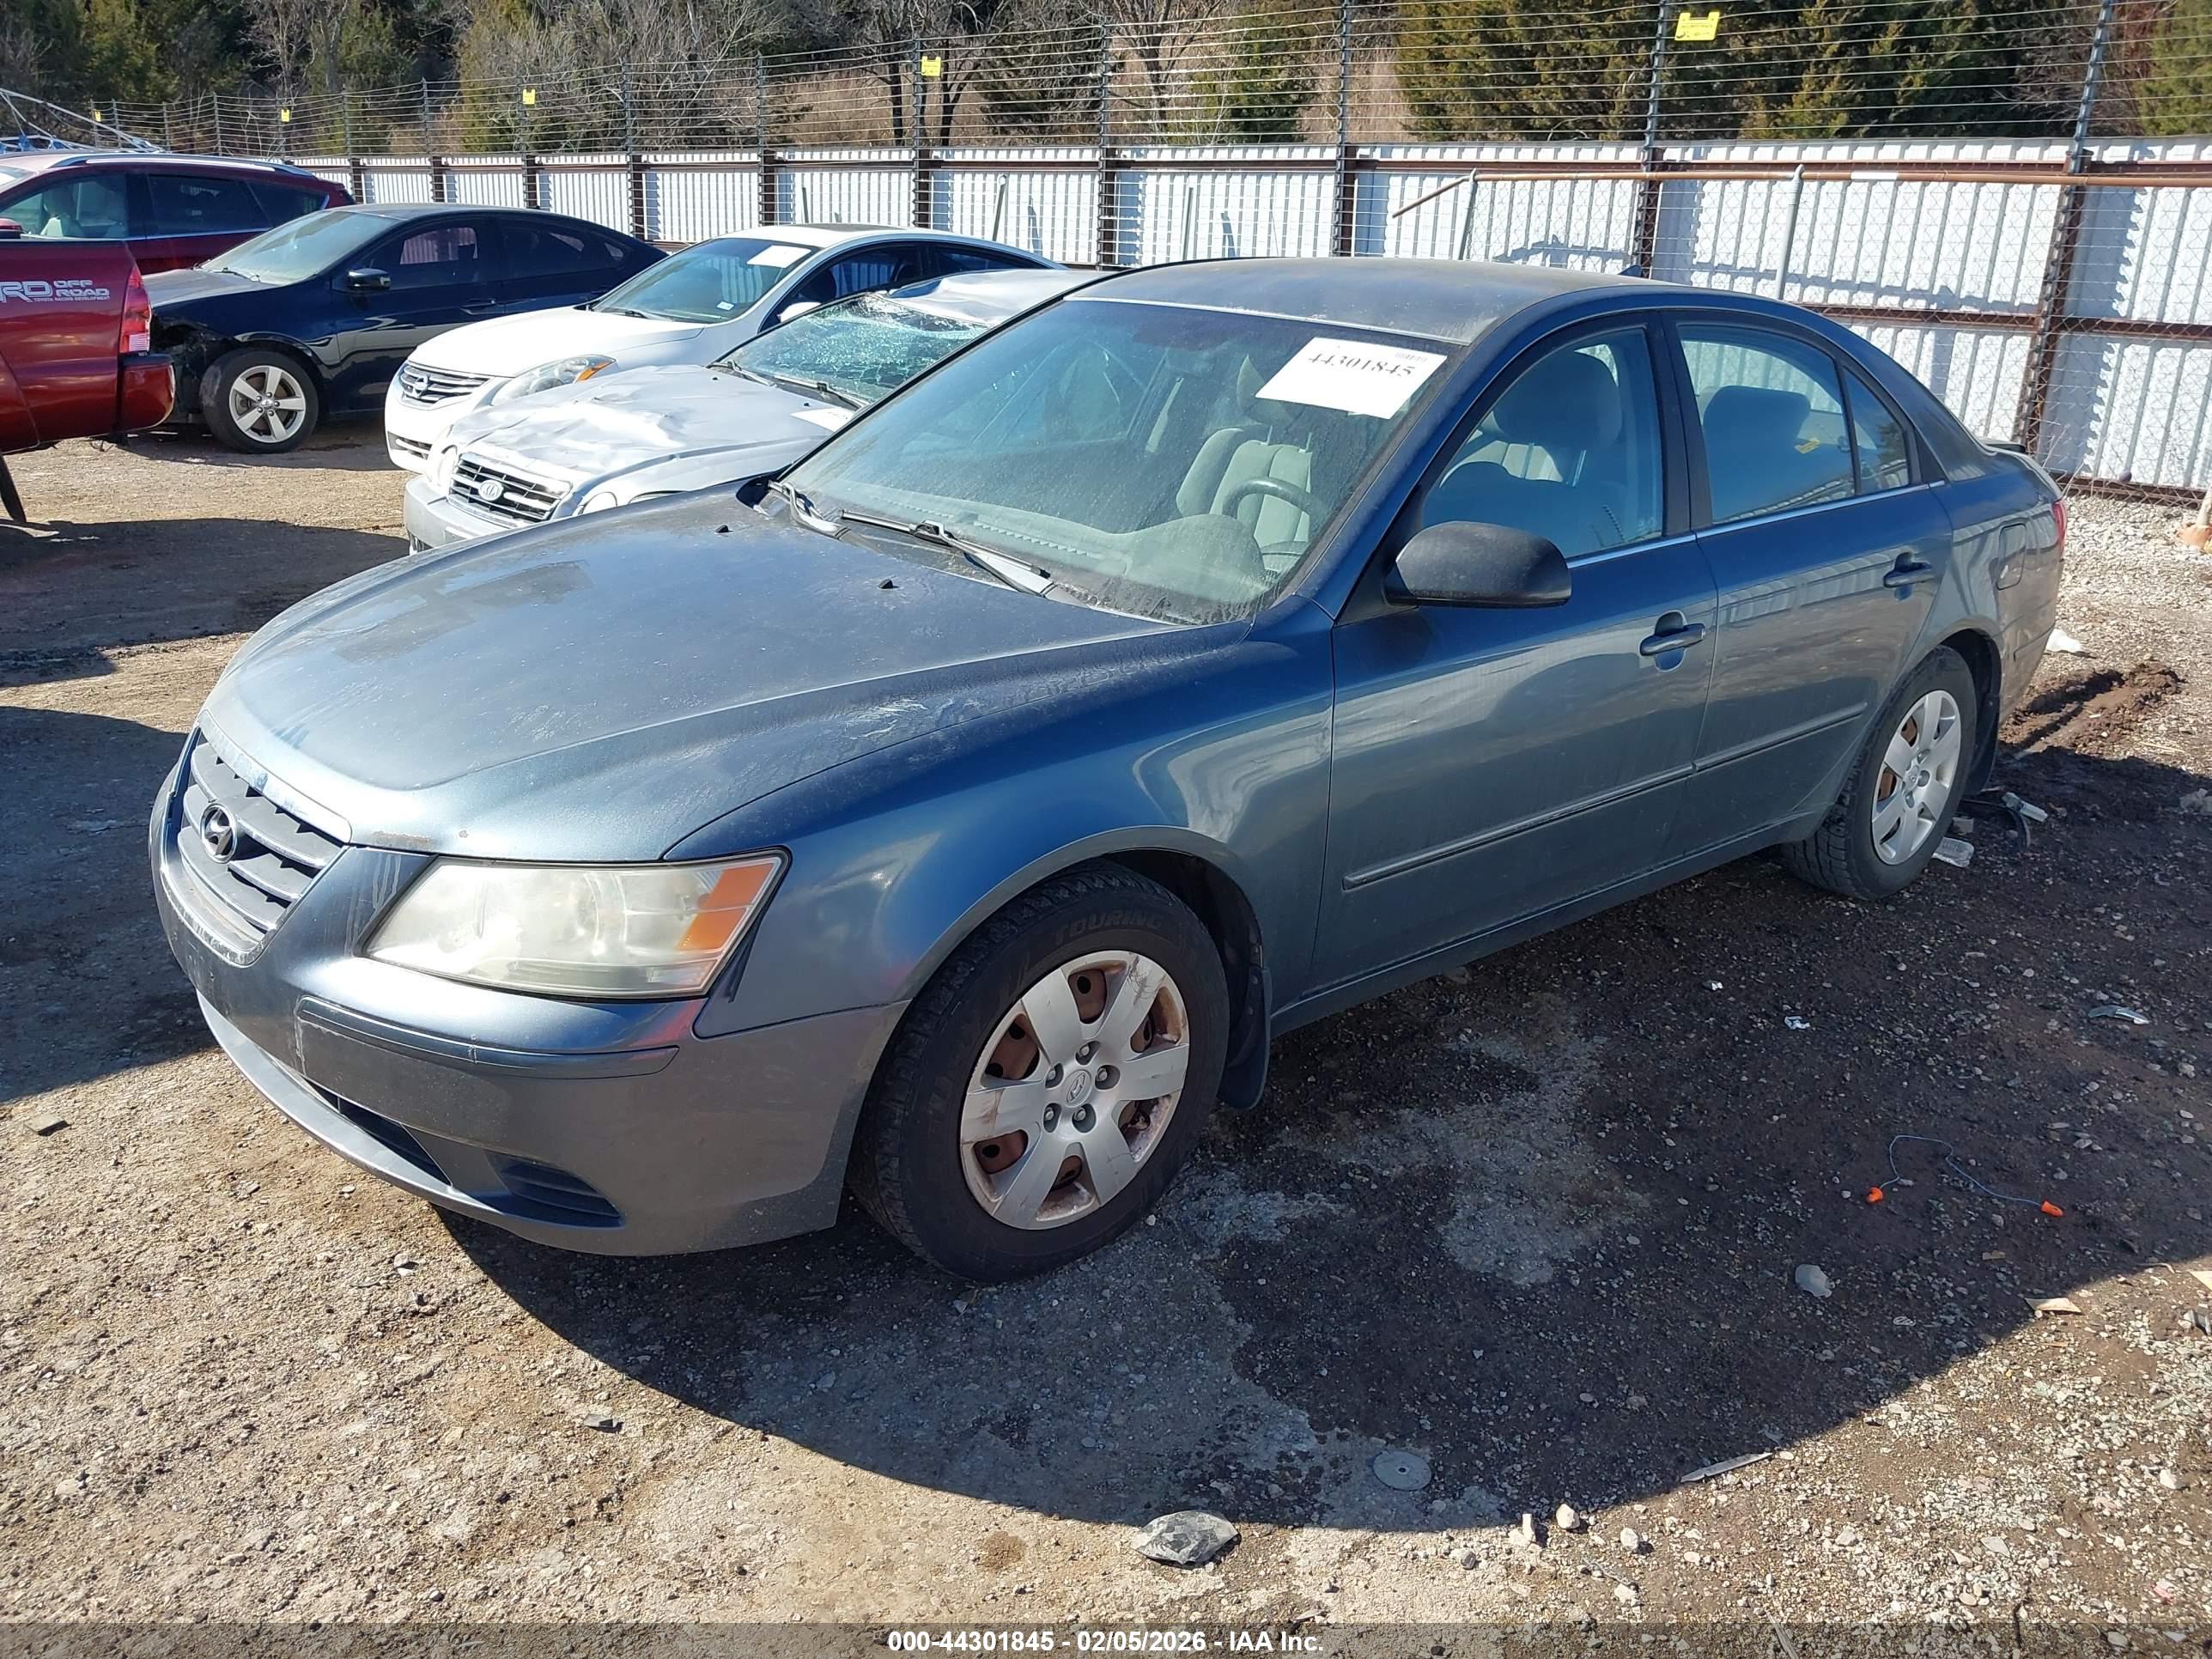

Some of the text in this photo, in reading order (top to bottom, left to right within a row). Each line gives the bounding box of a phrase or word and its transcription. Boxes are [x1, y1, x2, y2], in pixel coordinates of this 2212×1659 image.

[56, 289, 110, 297] ROAD
[1309, 353, 1415, 377] 44301845
[1054, 908, 1163, 945] TOURING
